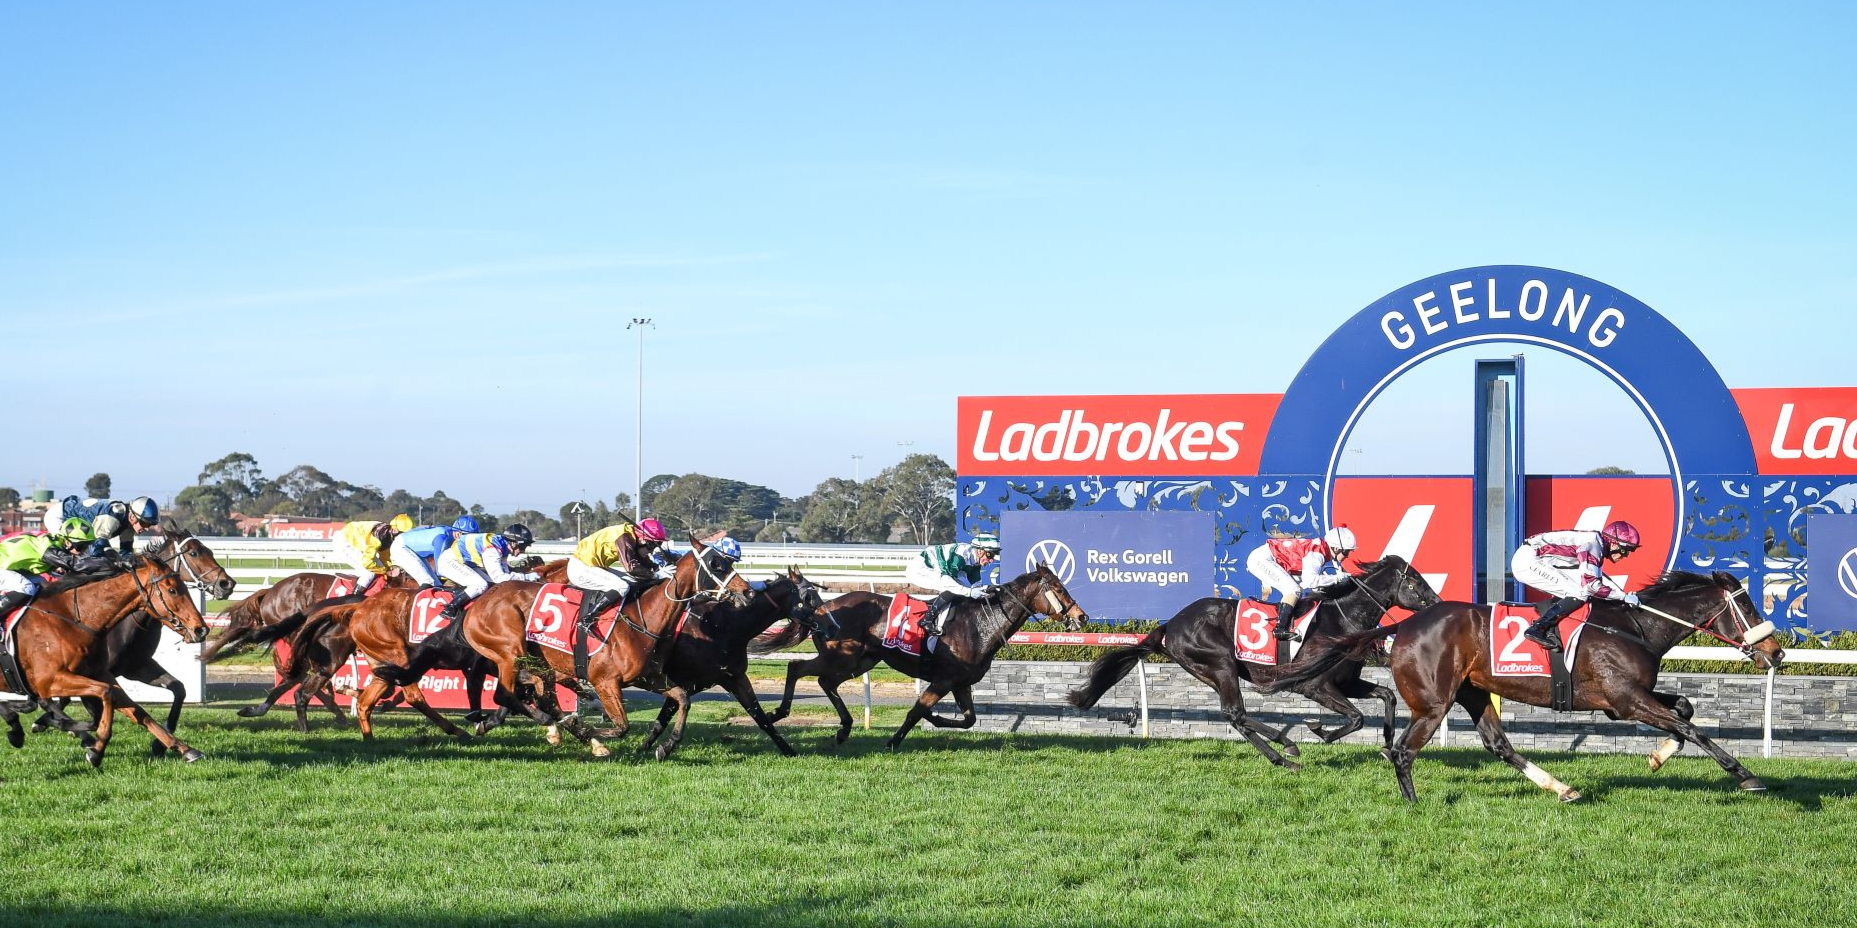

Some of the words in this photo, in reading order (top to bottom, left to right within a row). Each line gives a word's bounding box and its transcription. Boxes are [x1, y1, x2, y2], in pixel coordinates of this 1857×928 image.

[1381, 279, 1625, 350] GEELONG
[972, 409, 1244, 462] Ladbrokes
[273, 527, 324, 540] Ladbrokes
[1087, 549, 1118, 564] Rex
[1122, 549, 1173, 565] Gorell
[1087, 568, 1189, 587] Volkswagen
[416, 597, 447, 634] 12
[534, 592, 569, 633] 5
[891, 605, 911, 640] 4
[1044, 633, 1085, 644] Ladbrokes
[1097, 633, 1139, 645] Ladbrokes
[1239, 607, 1269, 650] 3
[1498, 615, 1532, 662] 2
[1237, 648, 1275, 662] Ladbrokes
[1496, 662, 1544, 673] Ladbrokes
[418, 675, 460, 692] Right
